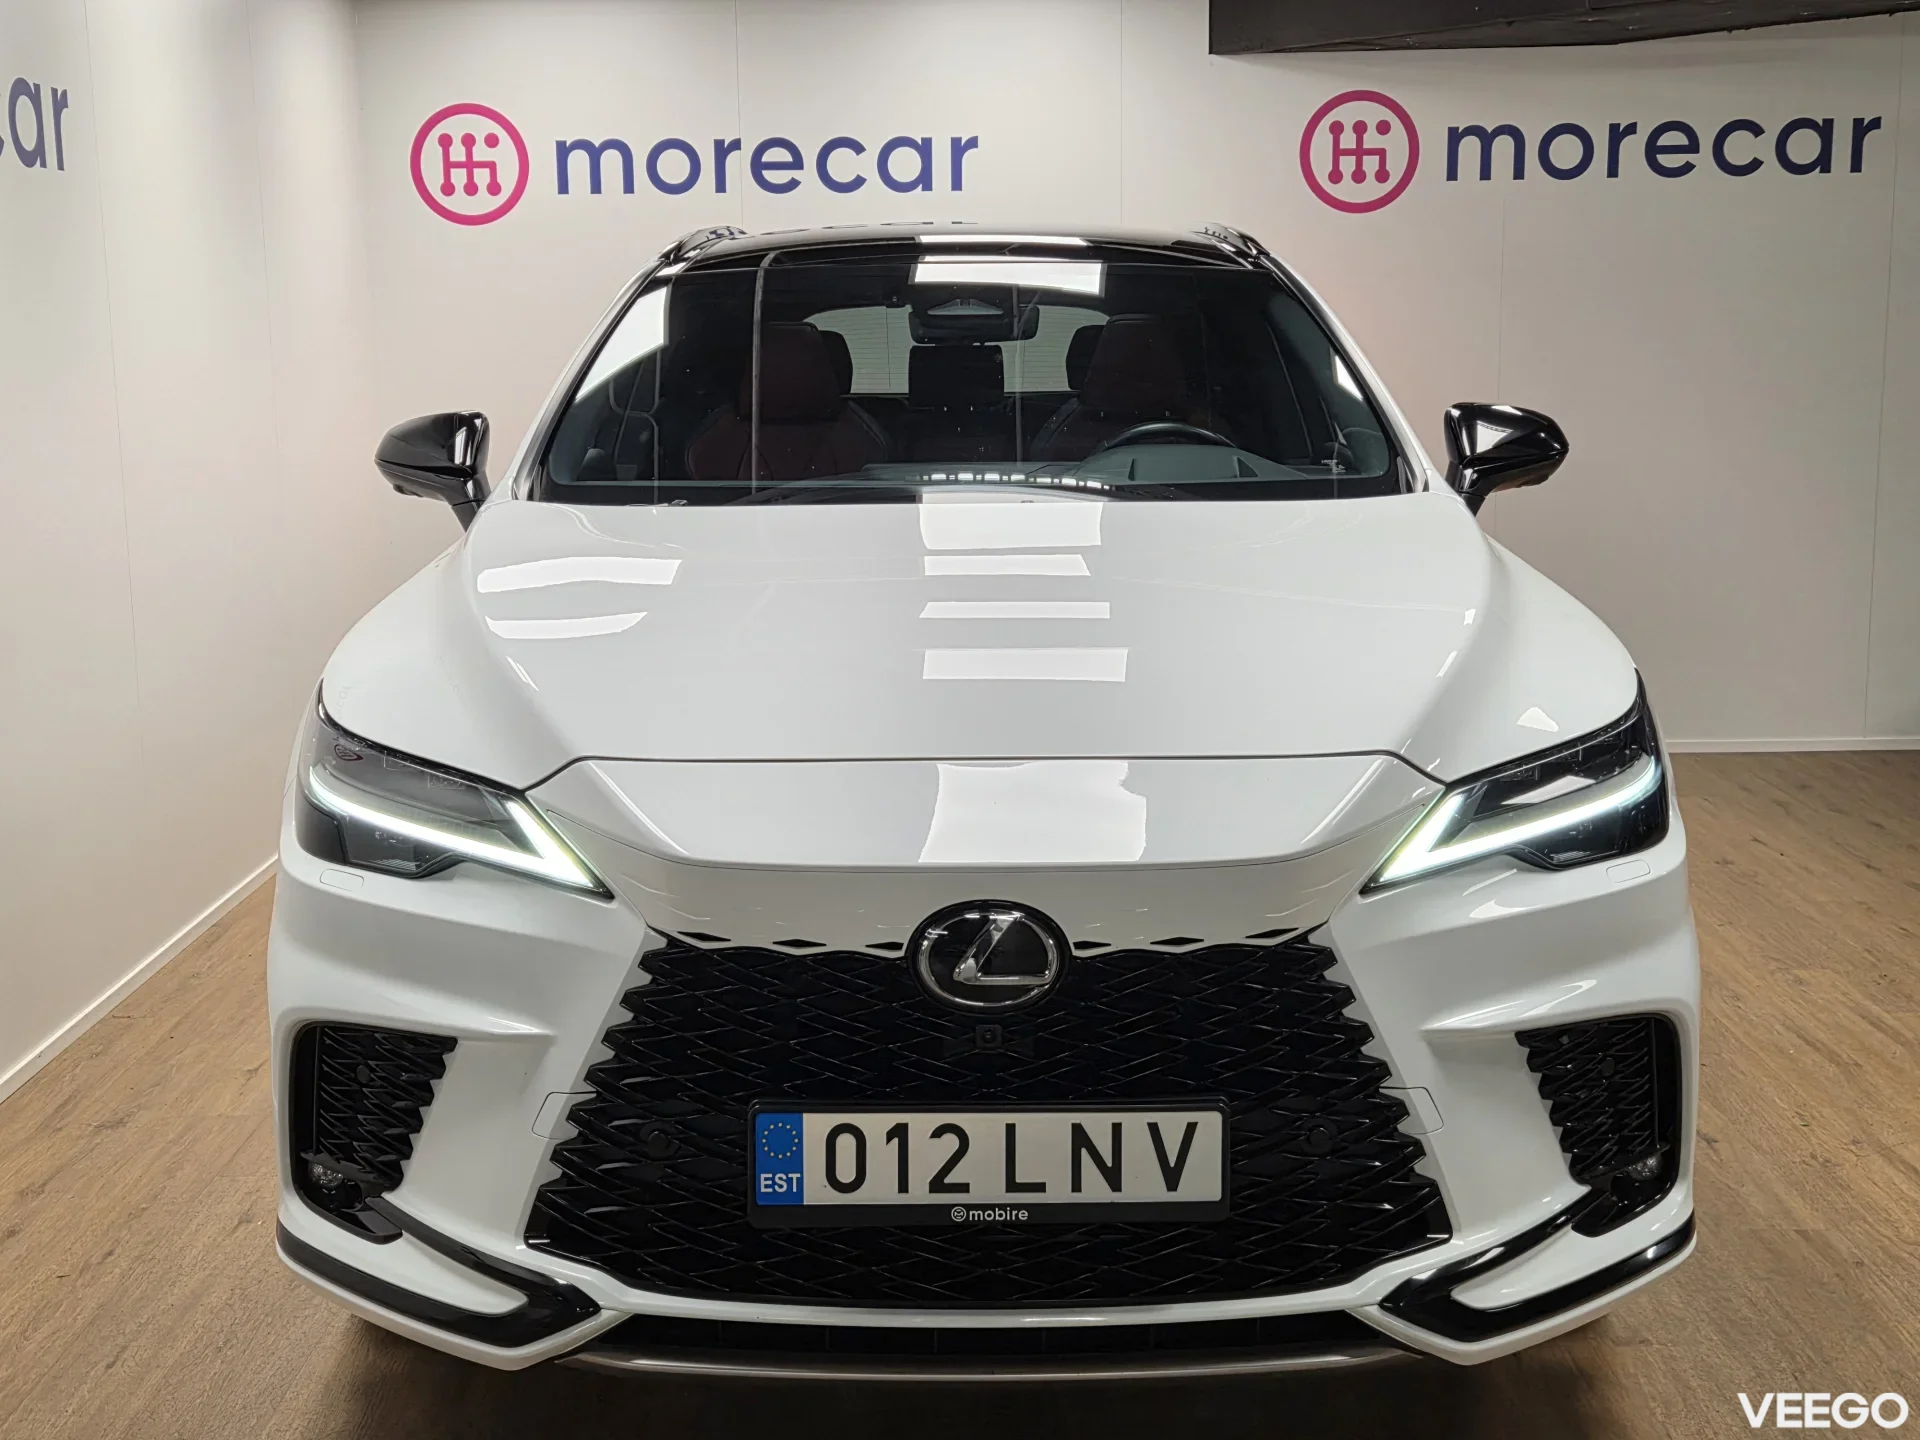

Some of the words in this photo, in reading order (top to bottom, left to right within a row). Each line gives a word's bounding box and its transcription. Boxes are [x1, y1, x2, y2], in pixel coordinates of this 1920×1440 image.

[0, 76, 69, 171] ar
[1445, 115, 1882, 182] morecar
[555, 135, 979, 195] morecar
[760, 1173, 801, 1194] EST
[825, 1122, 971, 1194] 012
[1005, 1121, 1199, 1193] LNV
[969, 1207, 1029, 1220] mobire
